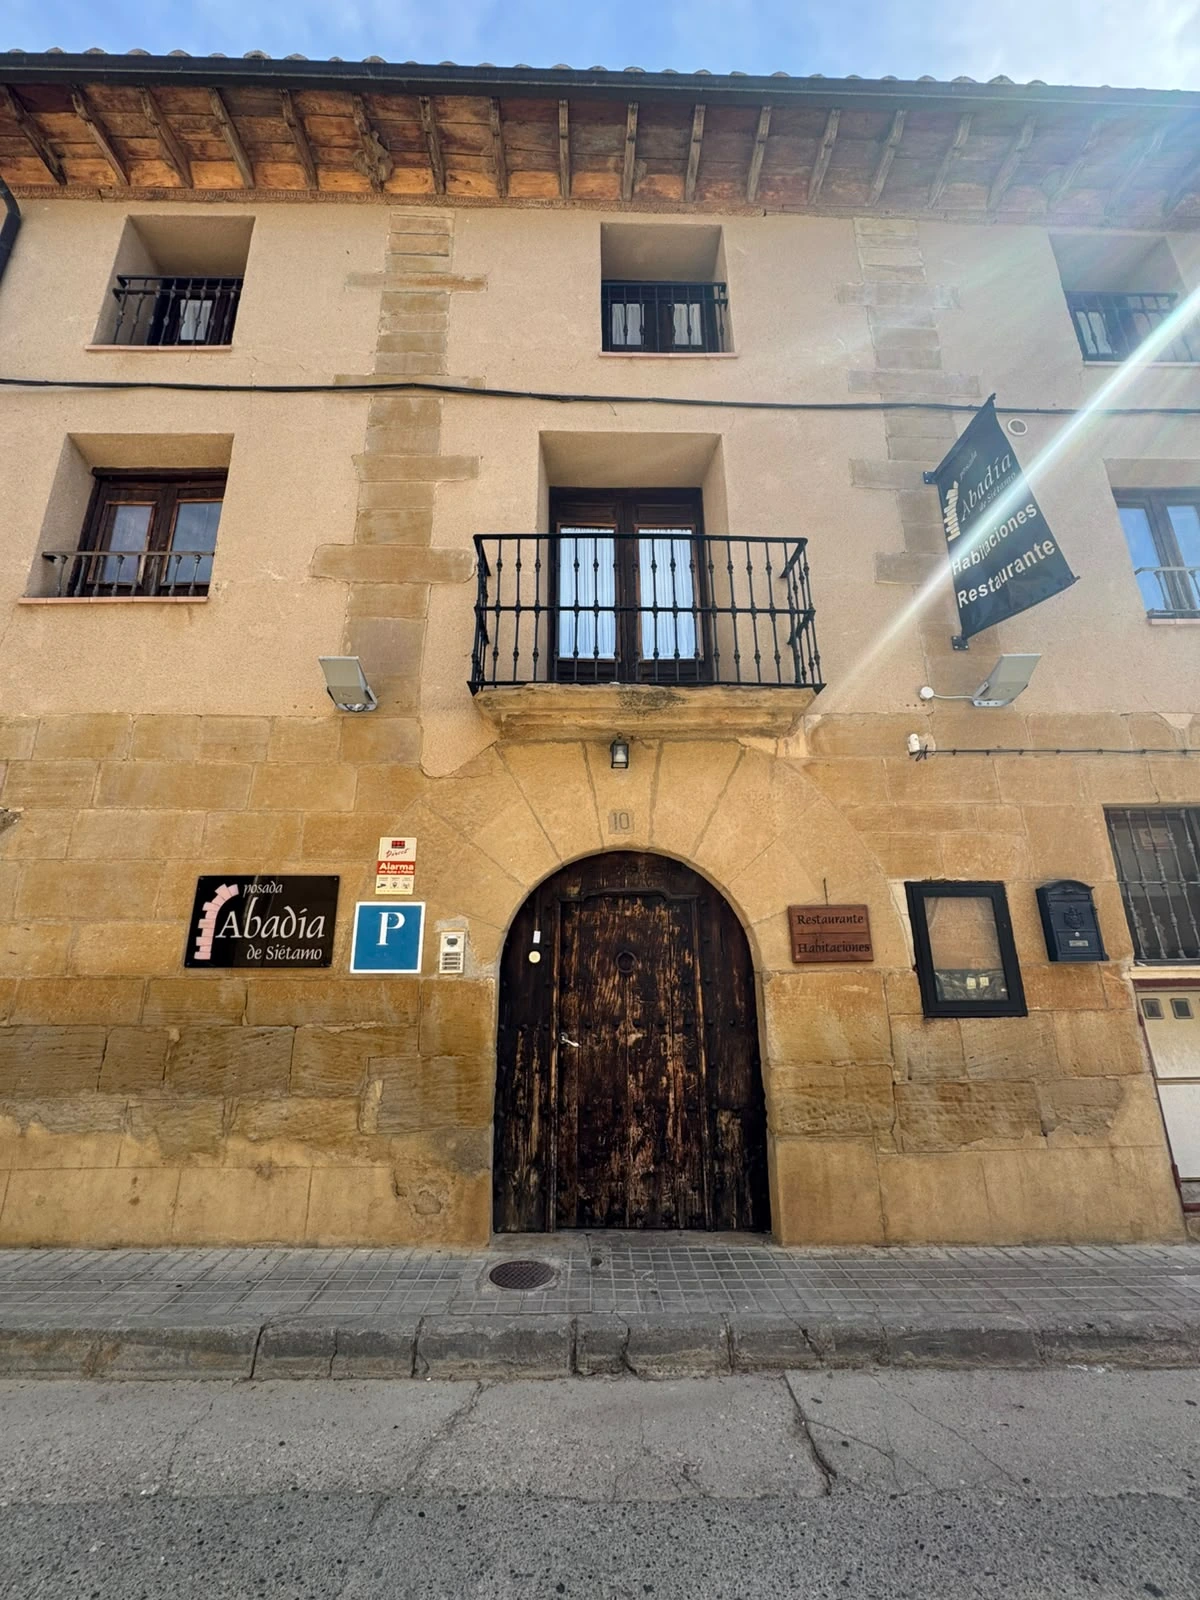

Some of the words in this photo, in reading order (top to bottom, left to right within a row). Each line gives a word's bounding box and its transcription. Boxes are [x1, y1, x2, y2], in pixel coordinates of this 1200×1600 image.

[961, 454, 1011, 522] Abadía
[951, 503, 1037, 575] Habitaciones
[957, 540, 1055, 608] Restaurante
[613, 812, 630, 830] 10
[379, 862, 414, 871] Alarma
[243, 880, 283, 898] posada
[215, 897, 325, 939] Abadía
[797, 914, 864, 925] Restaurante
[376, 912, 405, 946] P
[247, 944, 262, 960] de
[266, 944, 323, 960] Siétamo
[797, 939, 871, 953] Habitaciones
